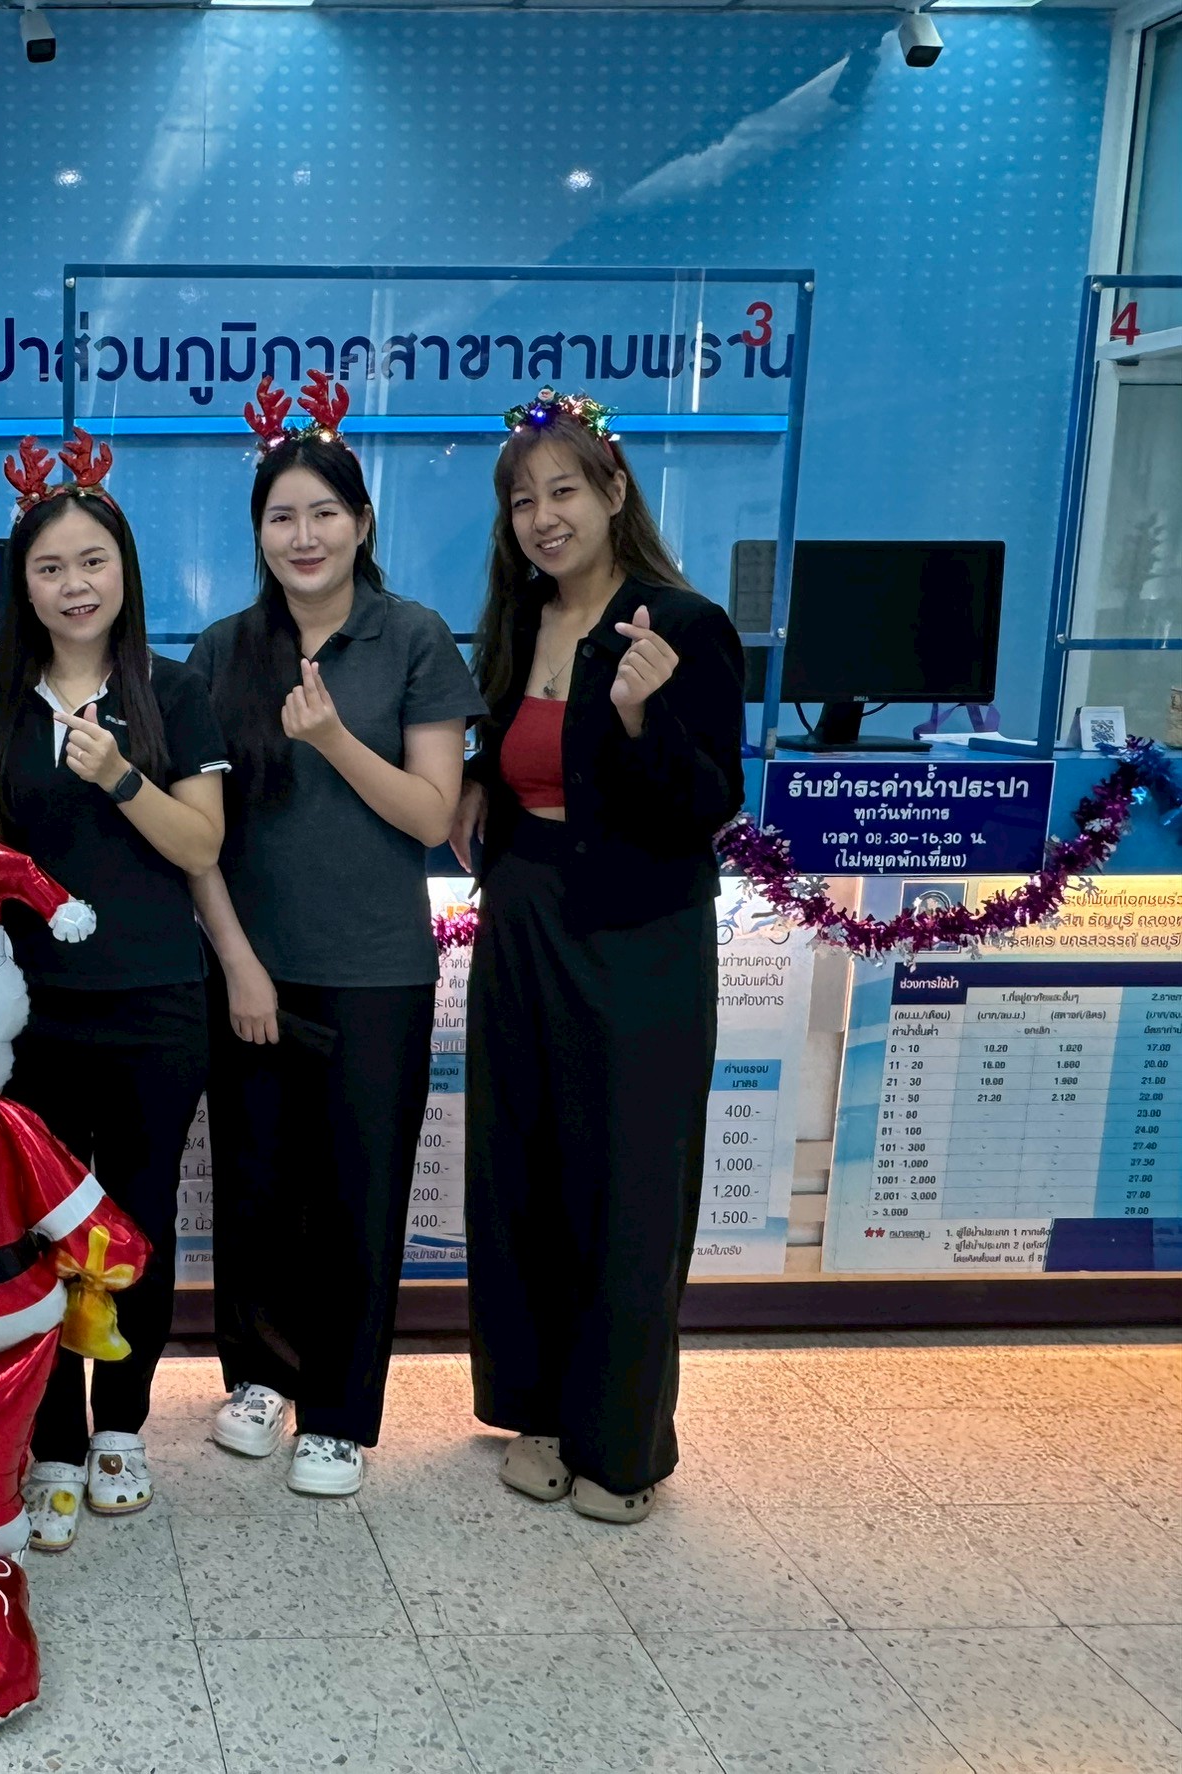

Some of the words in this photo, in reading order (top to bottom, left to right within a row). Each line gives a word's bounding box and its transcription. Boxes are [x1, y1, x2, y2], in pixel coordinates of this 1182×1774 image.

[742, 301, 773, 346] 3
[1109, 301, 1141, 346] 4
[853, 803, 950, 827] ทุกวันทำการ
[822, 832, 858, 845] เวลา
[834, 845, 967, 873] (ไม่หยุดพักเที่ยง)
[908, 1044, 920, 1053] 10
[888, 1061, 899, 1069] 11
[886, 1078, 898, 1086] 21
[884, 1094, 896, 1103] 31
[724, 1104, 761, 1118] 400.-
[722, 1131, 758, 1145] 600.-
[880, 1143, 896, 1152] 101
